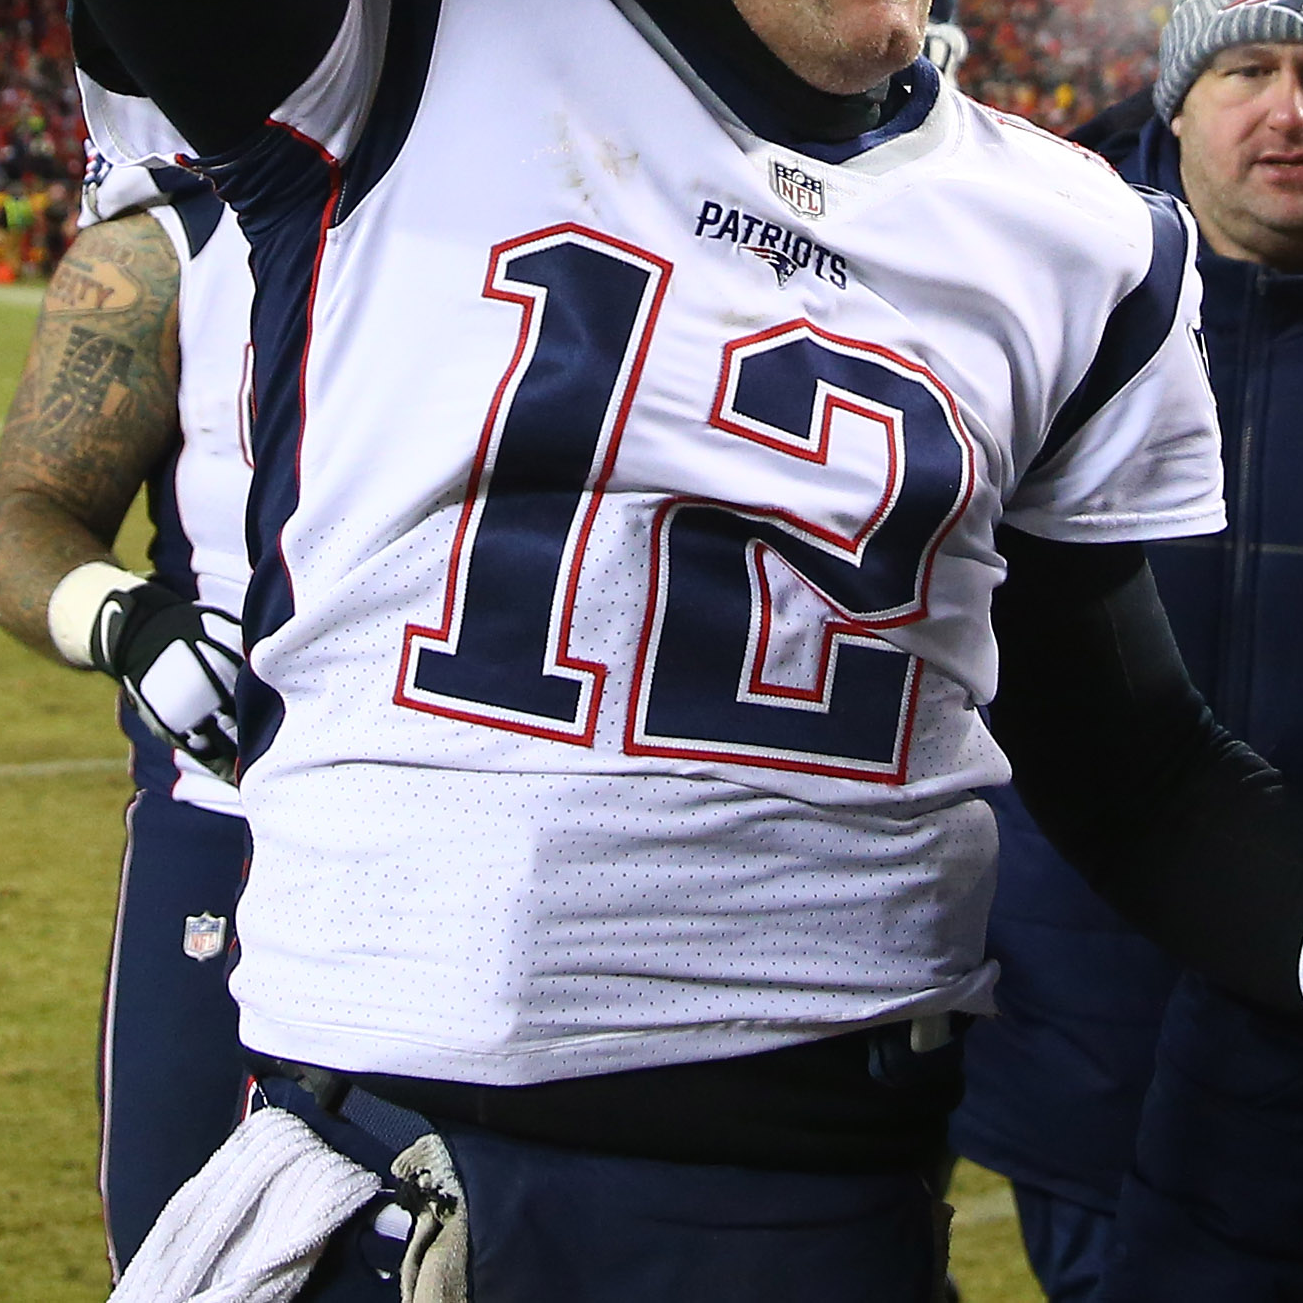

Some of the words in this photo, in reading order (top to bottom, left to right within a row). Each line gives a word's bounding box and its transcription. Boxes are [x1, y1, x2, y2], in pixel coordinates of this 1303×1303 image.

[780, 178, 819, 213] NFL
[694, 199, 848, 290] PATRIOTS
[393, 221, 975, 785] 12
